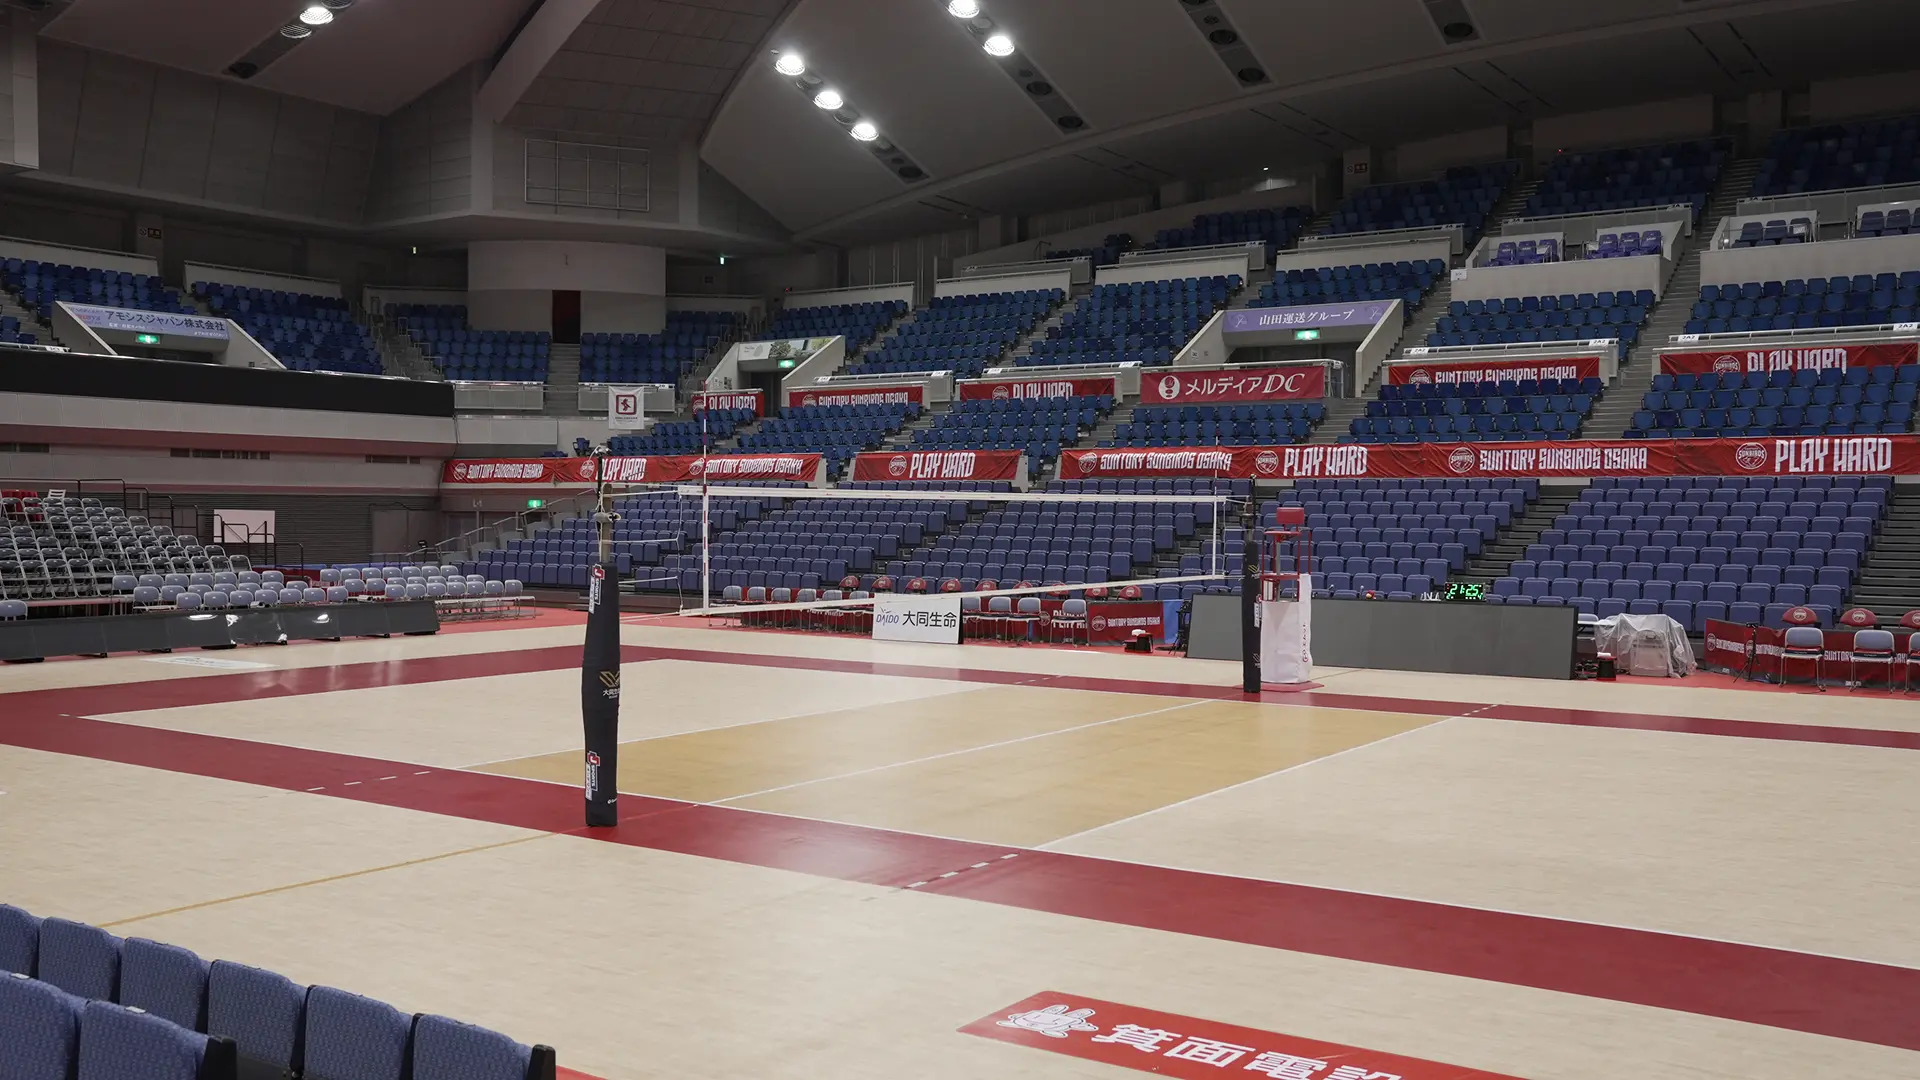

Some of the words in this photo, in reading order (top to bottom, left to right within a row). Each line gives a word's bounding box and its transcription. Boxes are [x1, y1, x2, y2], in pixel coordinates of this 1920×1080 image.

[105, 310, 225, 332] アモシスジャパン株式会社
[1259, 309, 1355, 326] 山田運送グループ
[1185, 375, 1262, 395] メルディア
[1263, 373, 1305, 394] DC
[909, 453, 941, 478] PLAY
[941, 452, 976, 477] HARD
[1100, 453, 1146, 470] SUNTORY
[1146, 452, 1195, 469] SUNBIRDS
[1196, 452, 1232, 471] OSAKA
[1283, 446, 1324, 476] PLAY
[1325, 446, 1368, 475] HARD
[1480, 449, 1535, 470] SUNTORY
[1538, 448, 1600, 470] SUNBIRDS
[1604, 447, 1647, 469] OSAKA
[1775, 439, 1828, 472] PLAY
[1833, 438, 1892, 471] HARD
[902, 610, 957, 629] 大同生命
